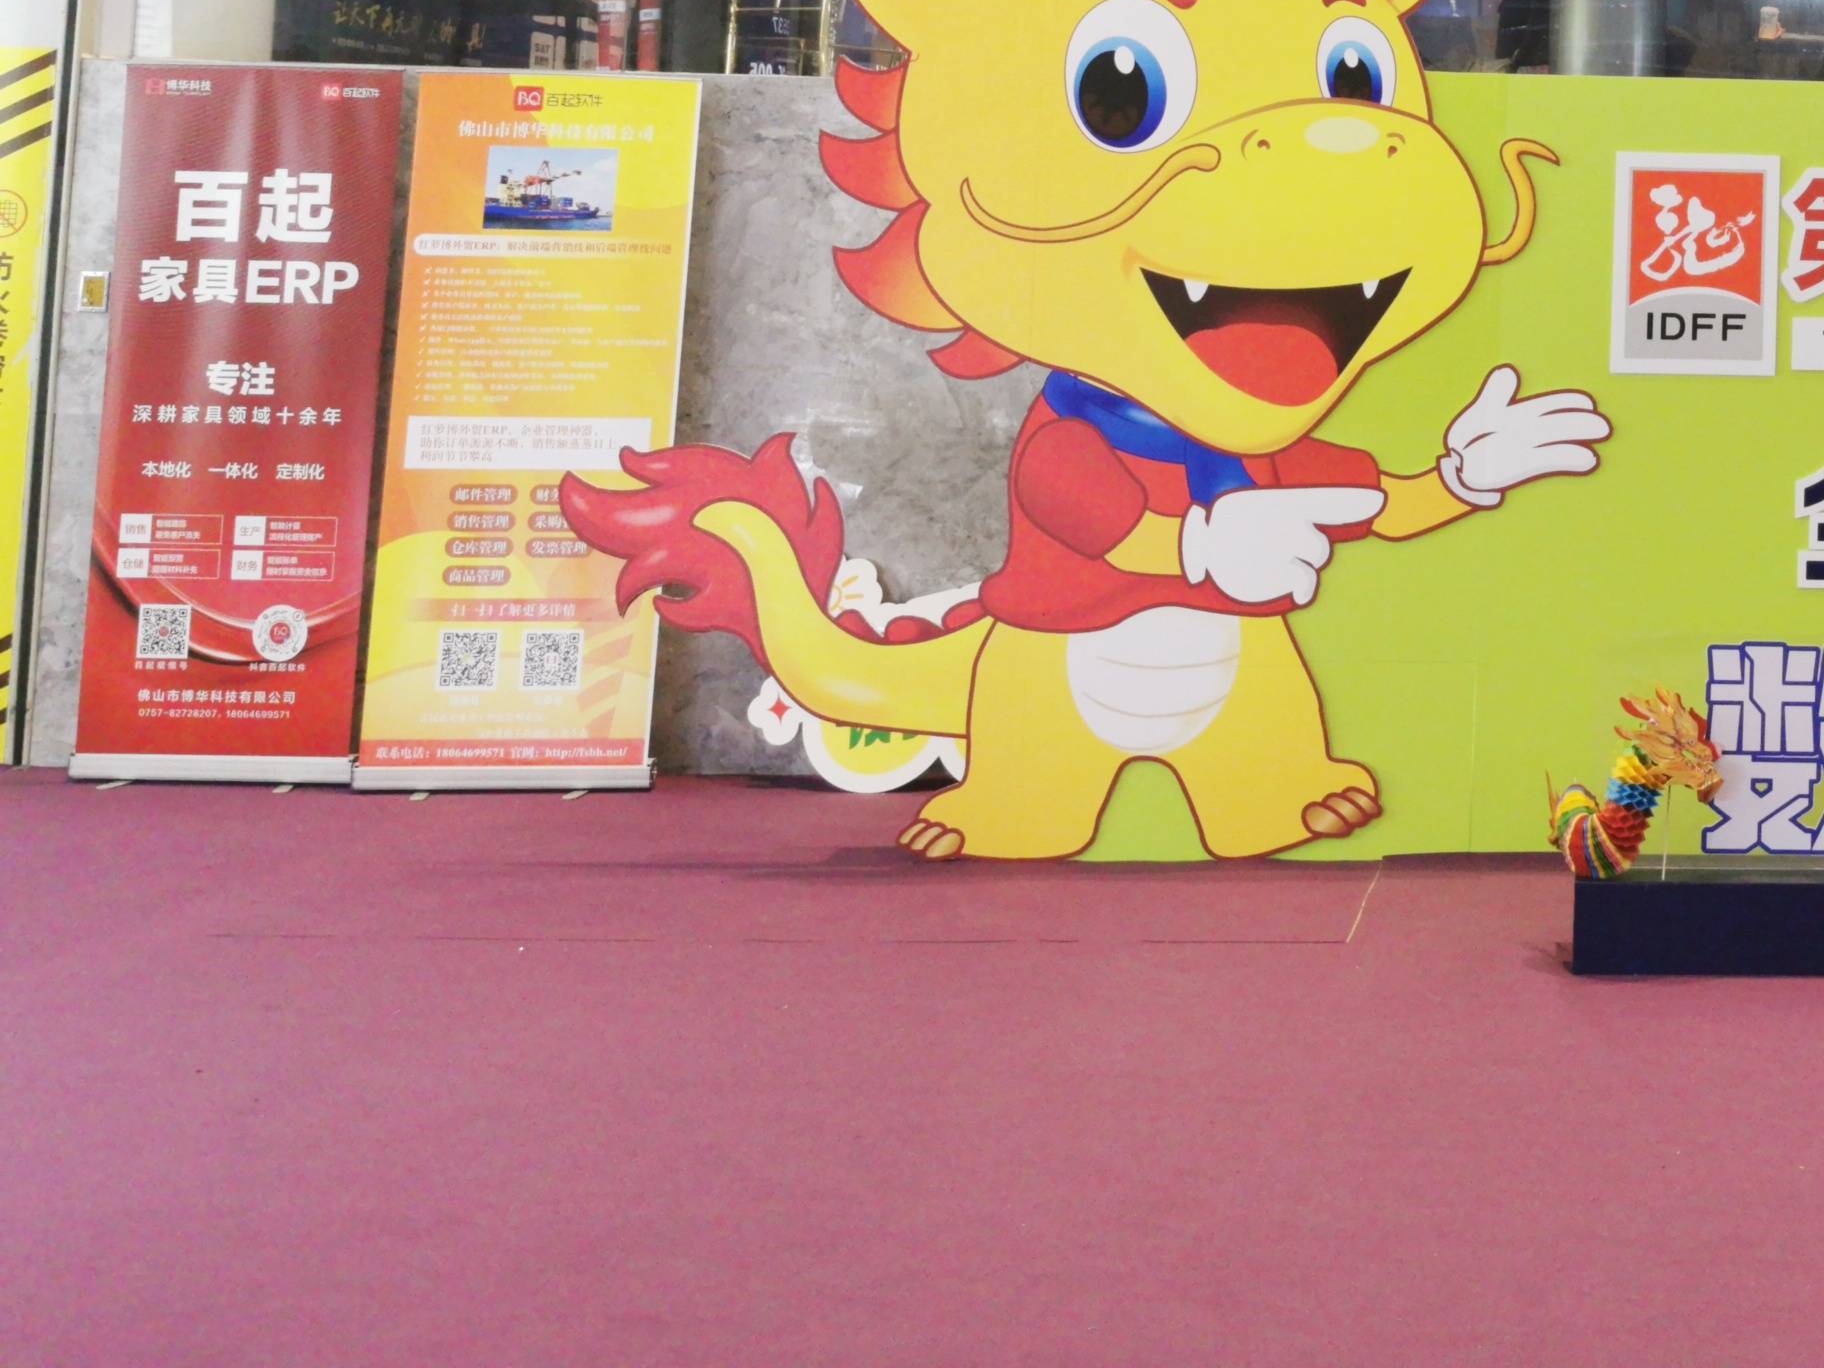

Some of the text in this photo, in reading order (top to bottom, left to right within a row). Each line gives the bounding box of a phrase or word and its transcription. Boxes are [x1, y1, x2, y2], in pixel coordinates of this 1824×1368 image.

[546, 92, 604, 109] 百起软件
[174, 168, 334, 244] 百起
[137, 255, 360, 306] 家具ERP
[1645, 312, 1747, 343] IDFF
[205, 360, 276, 397] 专注
[131, 404, 343, 427] 深耕家具领域十余年
[141, 460, 326, 481] 本地化 一体化 定制化
[455, 486, 512, 502] 邮件管理
[453, 513, 511, 529] 销售管理
[452, 539, 508, 555] 仓库管理
[448, 567, 506, 584] 商品管理
[137, 690, 298, 705] 佛山市博华科技有限公司
